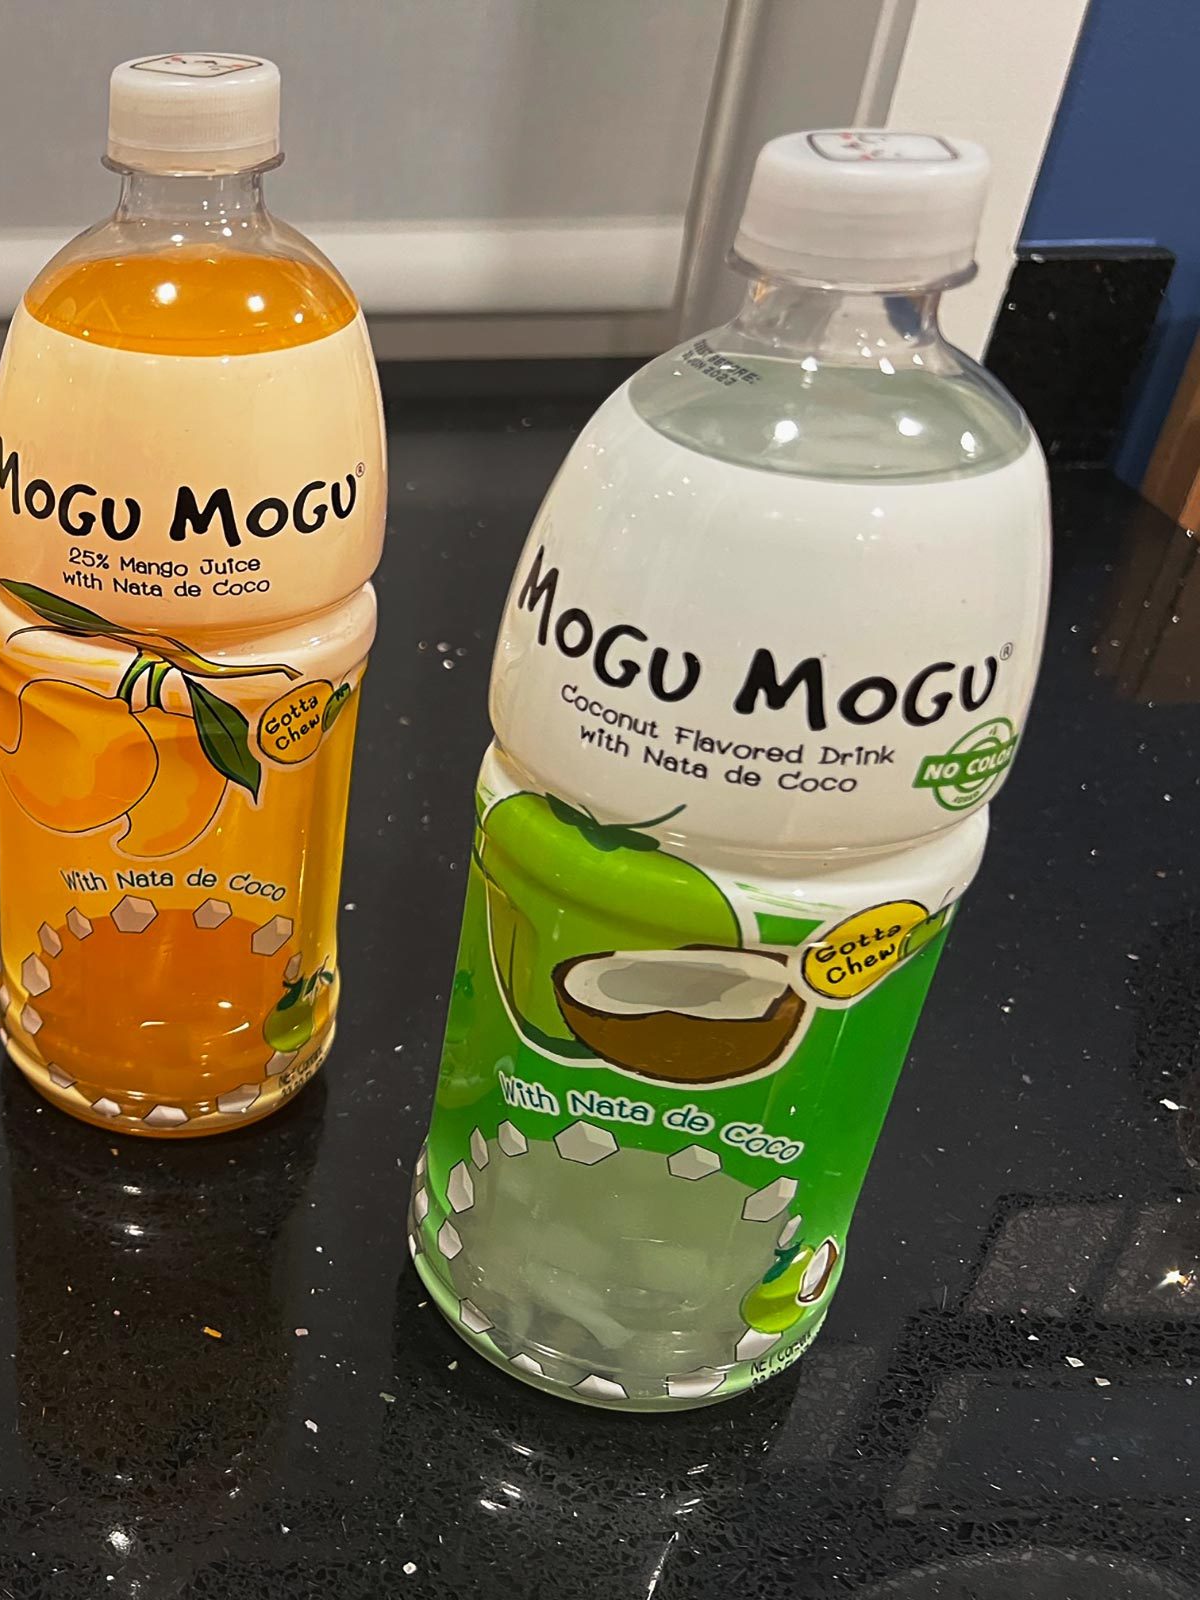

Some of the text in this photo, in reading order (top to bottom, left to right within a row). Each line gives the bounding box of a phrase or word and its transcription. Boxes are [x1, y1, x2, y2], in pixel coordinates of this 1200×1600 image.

[68, 546, 261, 579] 25% Mango Juice
[62, 570, 271, 598] with Nata de Coco
[264, 695, 319, 735] Gotta
[275, 713, 321, 751] Chew
[561, 680, 895, 768] Coconut Flavored Drink
[580, 722, 858, 793] with Nata de Coco
[922, 761, 960, 781] NO
[59, 867, 288, 903] With Nata de Coco
[814, 924, 902, 964] Gotta
[826, 943, 896, 984] Chew
[498, 1071, 801, 1162] With Nata de Coco
